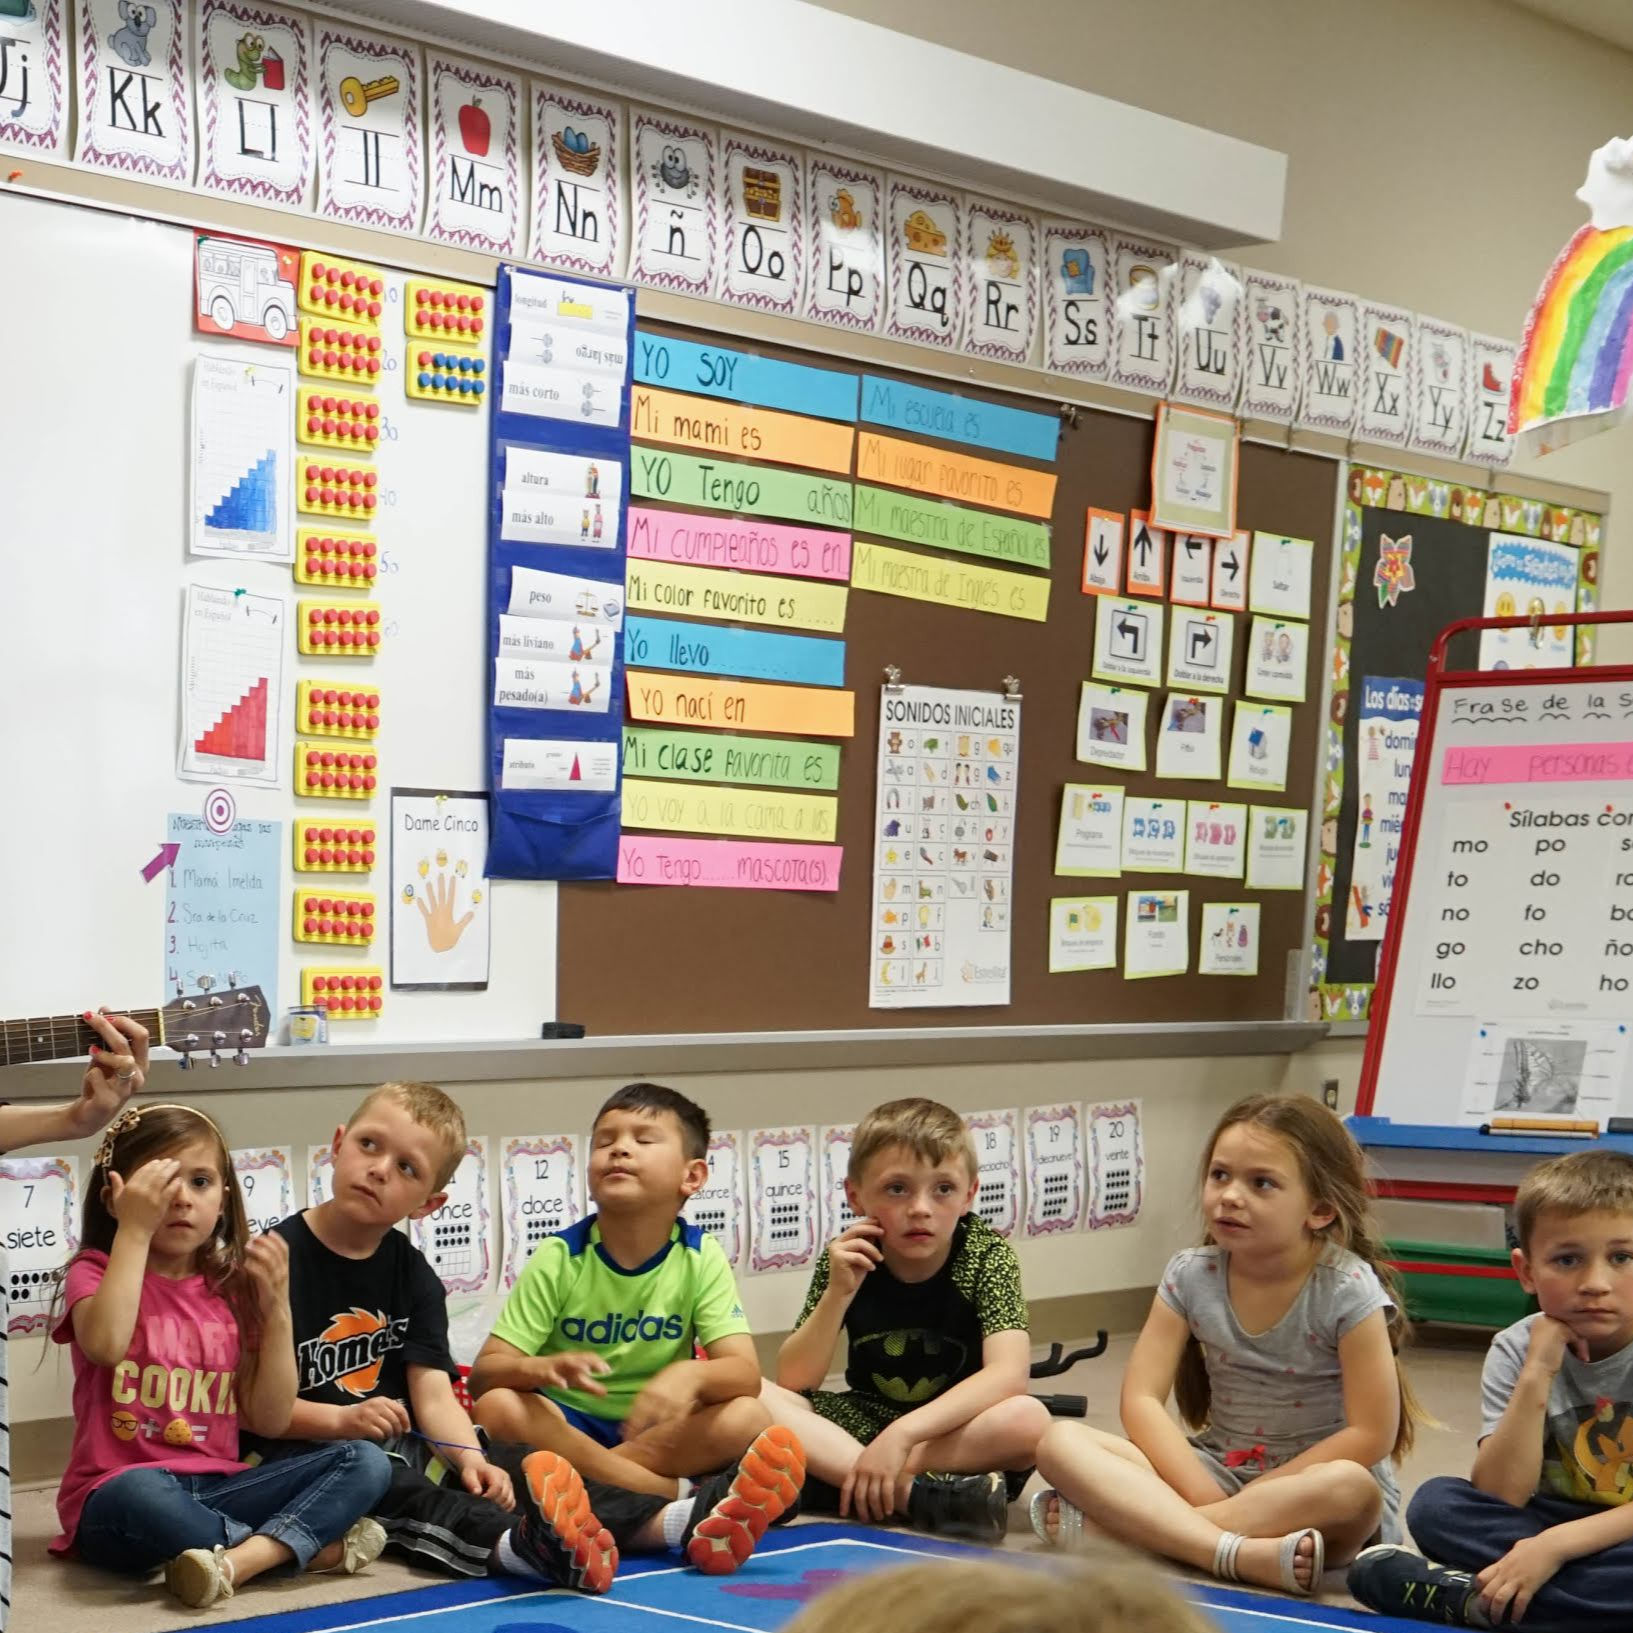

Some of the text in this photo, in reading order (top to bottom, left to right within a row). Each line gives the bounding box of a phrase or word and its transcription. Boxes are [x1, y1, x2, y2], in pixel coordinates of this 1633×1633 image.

[109, 68, 164, 136] Kk
[239, 99, 276, 163] Ll
[451, 155, 504, 214] Mm
[557, 180, 599, 242] Nn
[668, 209, 687, 259] ñ
[741, 223, 785, 280] Oo
[829, 246, 864, 308] Pp
[514, 293, 548, 309] longitud
[907, 260, 950, 328] Qq
[987, 280, 1020, 332] Rr
[1064, 300, 1099, 347] Ss
[1131, 313, 1160, 361] Tt
[1195, 328, 1227, 376] Uu
[696, 353, 738, 391] SOY
[1258, 345, 1289, 391] Vv
[1315, 361, 1352, 398] Ww
[508, 381, 560, 401] más corto
[1373, 372, 1400, 417] Xx
[634, 395, 763, 451] Mi mami es
[869, 384, 896, 417] Mi
[904, 400, 955, 433] escuela
[1429, 387, 1456, 438] Yy
[1481, 403, 1507, 443] Zz
[863, 438, 887, 480] Mi
[521, 472, 549, 486] altura
[698, 464, 851, 522] Tengo años
[511, 510, 555, 526] más alto
[858, 491, 881, 521] Mi
[957, 517, 975, 549] de
[630, 516, 810, 569] Mi cumpleaños es
[853, 546, 878, 585] Mi
[935, 572, 950, 598] de
[528, 589, 552, 604] peso
[627, 574, 648, 601] Mi
[654, 582, 694, 607] color
[704, 588, 767, 616] favorito
[503, 634, 554, 651] más liviano
[669, 633, 710, 667] llevo
[514, 667, 535, 681] más
[498, 688, 548, 706] pesado(a)
[675, 690, 746, 723] nací en
[1365, 685, 1410, 711] Los días
[1542, 694, 1570, 710] de
[1587, 693, 1606, 709] la
[885, 699, 1015, 730] SONIDOS INICIALES
[622, 735, 646, 769] Mi
[657, 742, 713, 774] clase
[725, 748, 791, 781] favorita
[1445, 752, 1619, 784] Hay personas
[404, 813, 479, 832] Dame Cinco
[1509, 809, 1591, 828] Sílabas
[1452, 838, 1567, 856] mo po
[183, 865, 263, 890] Mamá Imelda
[1447, 869, 1561, 888] to do
[183, 903, 203, 926] Sra
[206, 912, 215, 922] de
[217, 908, 227, 923] la
[230, 908, 259, 924] Cruz
[1441, 907, 1470, 922] no
[1524, 904, 1547, 921] fo
[1435, 939, 1633, 960] go cho ño
[1430, 972, 1629, 992] llo zo ho
[985, 1131, 997, 1150] 18
[1049, 1124, 1061, 1143] 19
[1108, 1120, 1125, 1139] 20
[535, 1159, 549, 1180] 12
[778, 1150, 790, 1169] 15
[1105, 1150, 1130, 1162] veinte
[23, 1184, 35, 1209] 7
[243, 1175, 255, 1198] 9
[765, 1181, 803, 1204] quince
[521, 1196, 564, 1216] doce
[6, 1226, 57, 1250] siete
[560, 1309, 684, 1345] adidas
